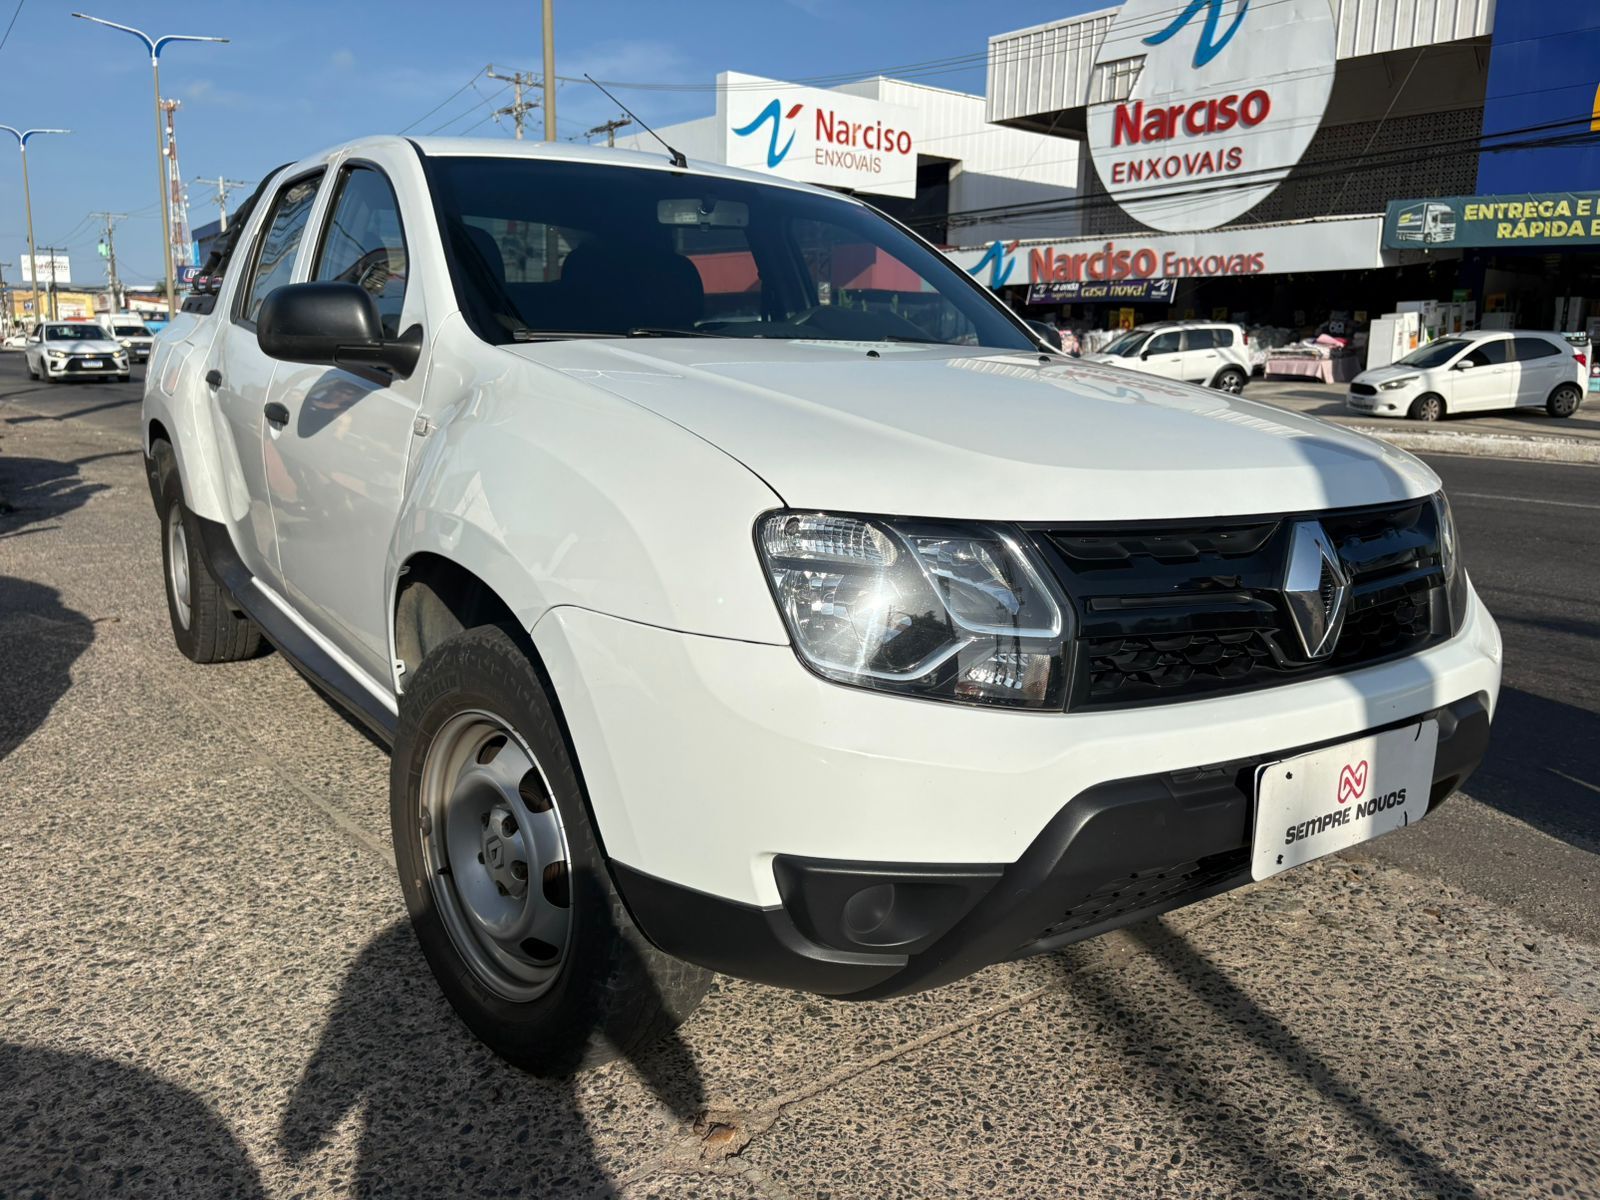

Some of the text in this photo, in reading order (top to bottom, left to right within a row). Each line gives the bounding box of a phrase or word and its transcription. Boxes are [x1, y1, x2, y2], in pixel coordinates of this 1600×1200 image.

[815, 108, 912, 155] Narciso
[1111, 89, 1271, 147] Narciso
[815, 148, 882, 173] ENXOVAIS
[1111, 147, 1243, 184] ENXOVAIS
[1464, 200, 1571, 220] ENTREGA
[1576, 199, 1593, 216] E
[1497, 218, 1585, 238] RÁPIDA
[1029, 242, 1265, 282] Narciso Enxovais
[1081, 285, 1107, 297] casa
[1109, 282, 1148, 297] nova!
[1285, 806, 1352, 845] SEMPRE
